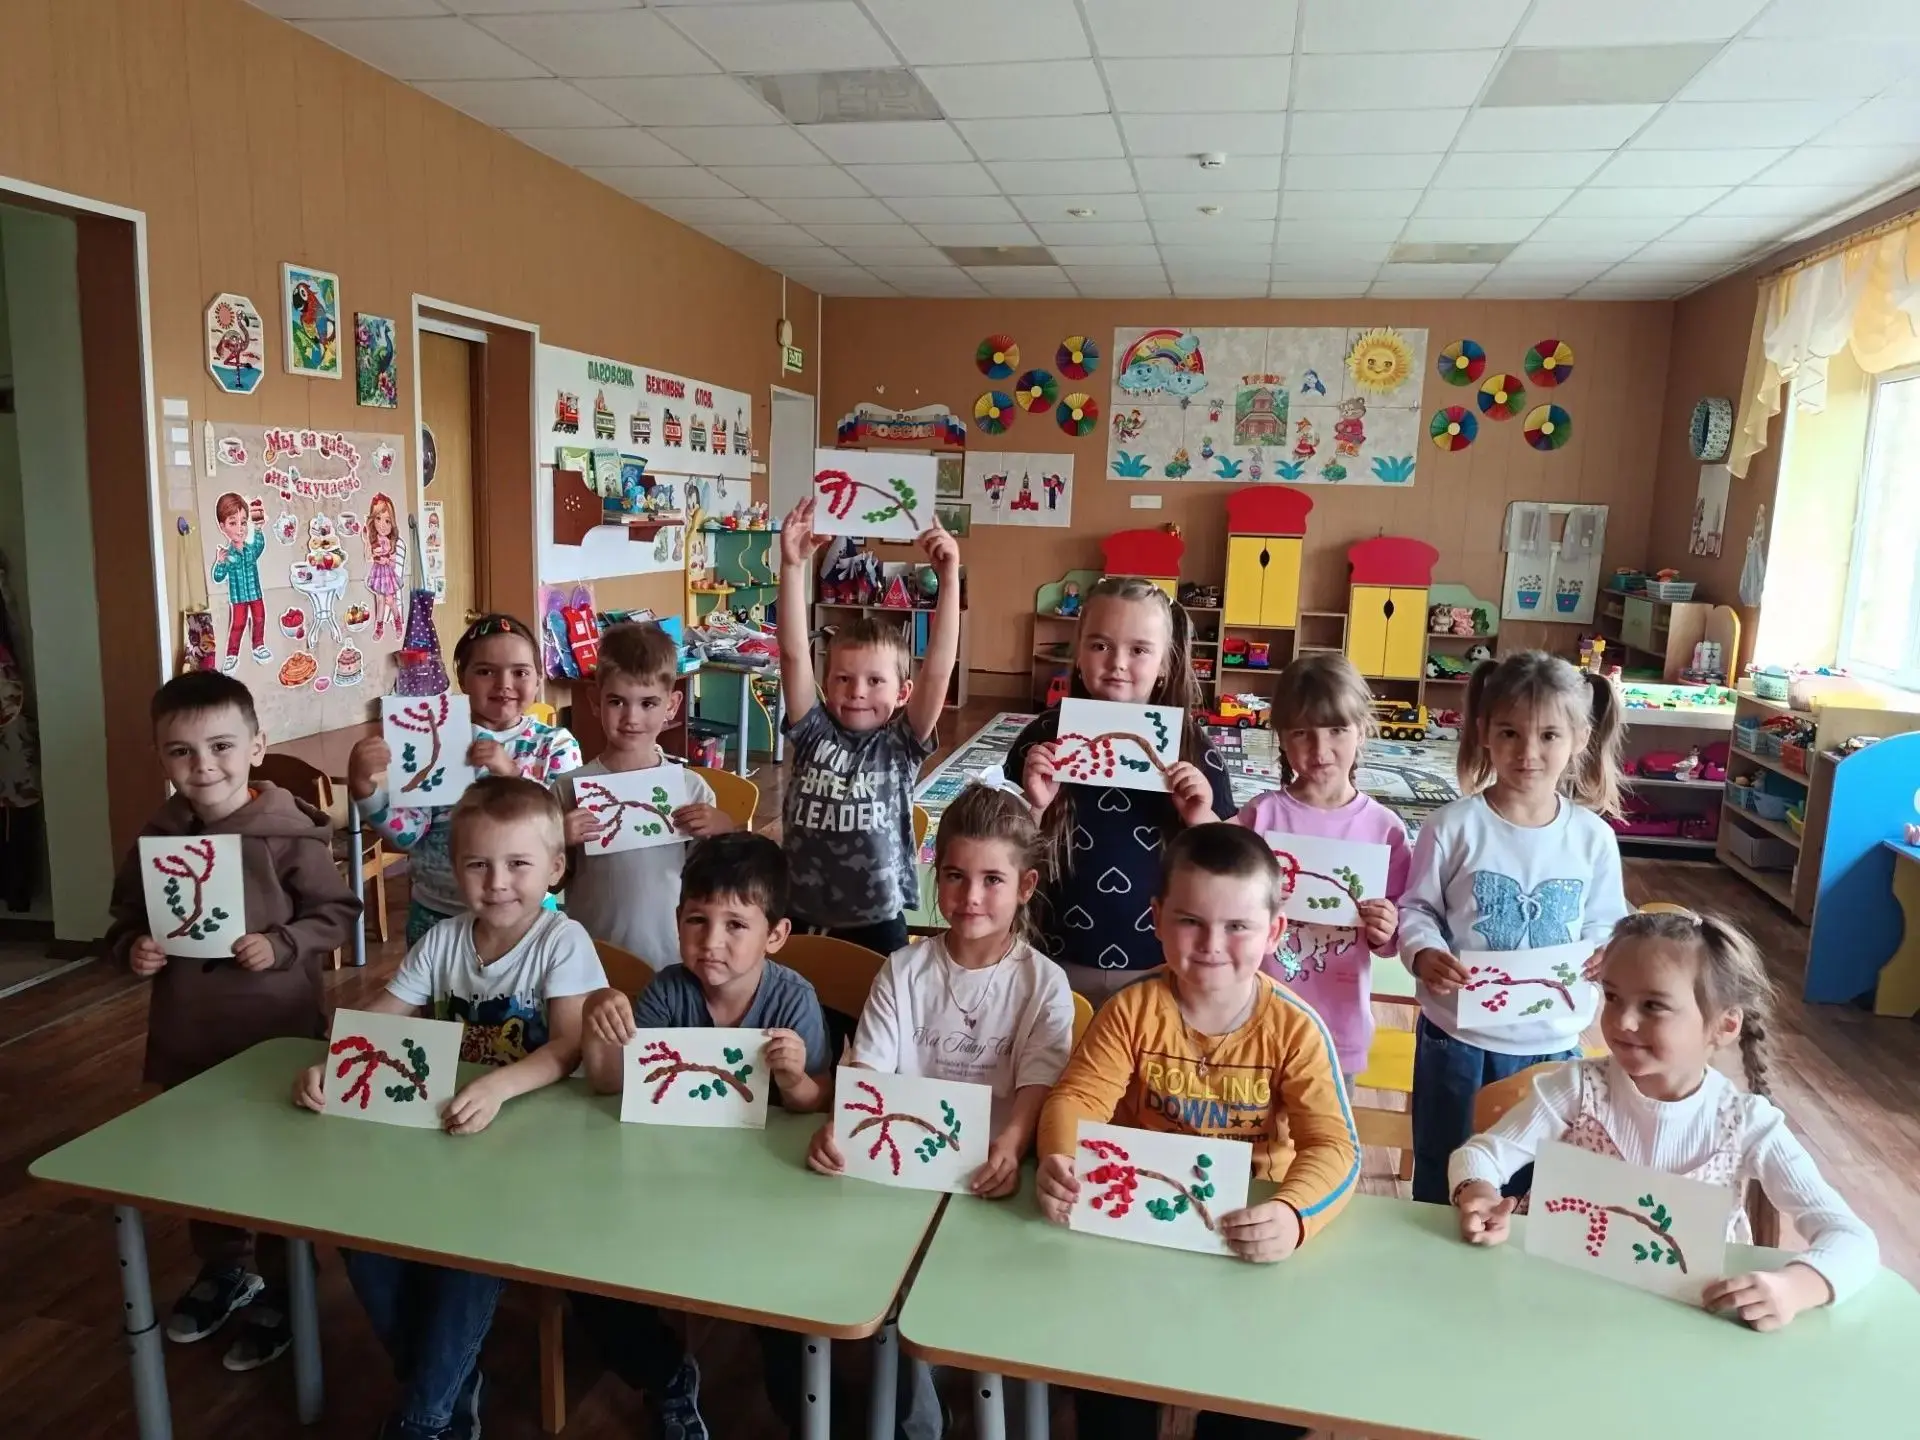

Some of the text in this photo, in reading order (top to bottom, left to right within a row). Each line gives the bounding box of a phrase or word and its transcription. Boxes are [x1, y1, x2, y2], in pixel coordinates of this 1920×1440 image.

[588, 361, 634, 387] ПАРОВОЗИК
[646, 374, 685, 399] ВЕЖЛИВЫХ
[266, 431, 295, 451] Мы
[814, 739, 848, 773] WIN
[795, 798, 888, 833] LEADER
[942, 1031, 986, 1062] Today
[1146, 1061, 1271, 1104] ROLLING
[1146, 1090, 1229, 1128] DOWN
